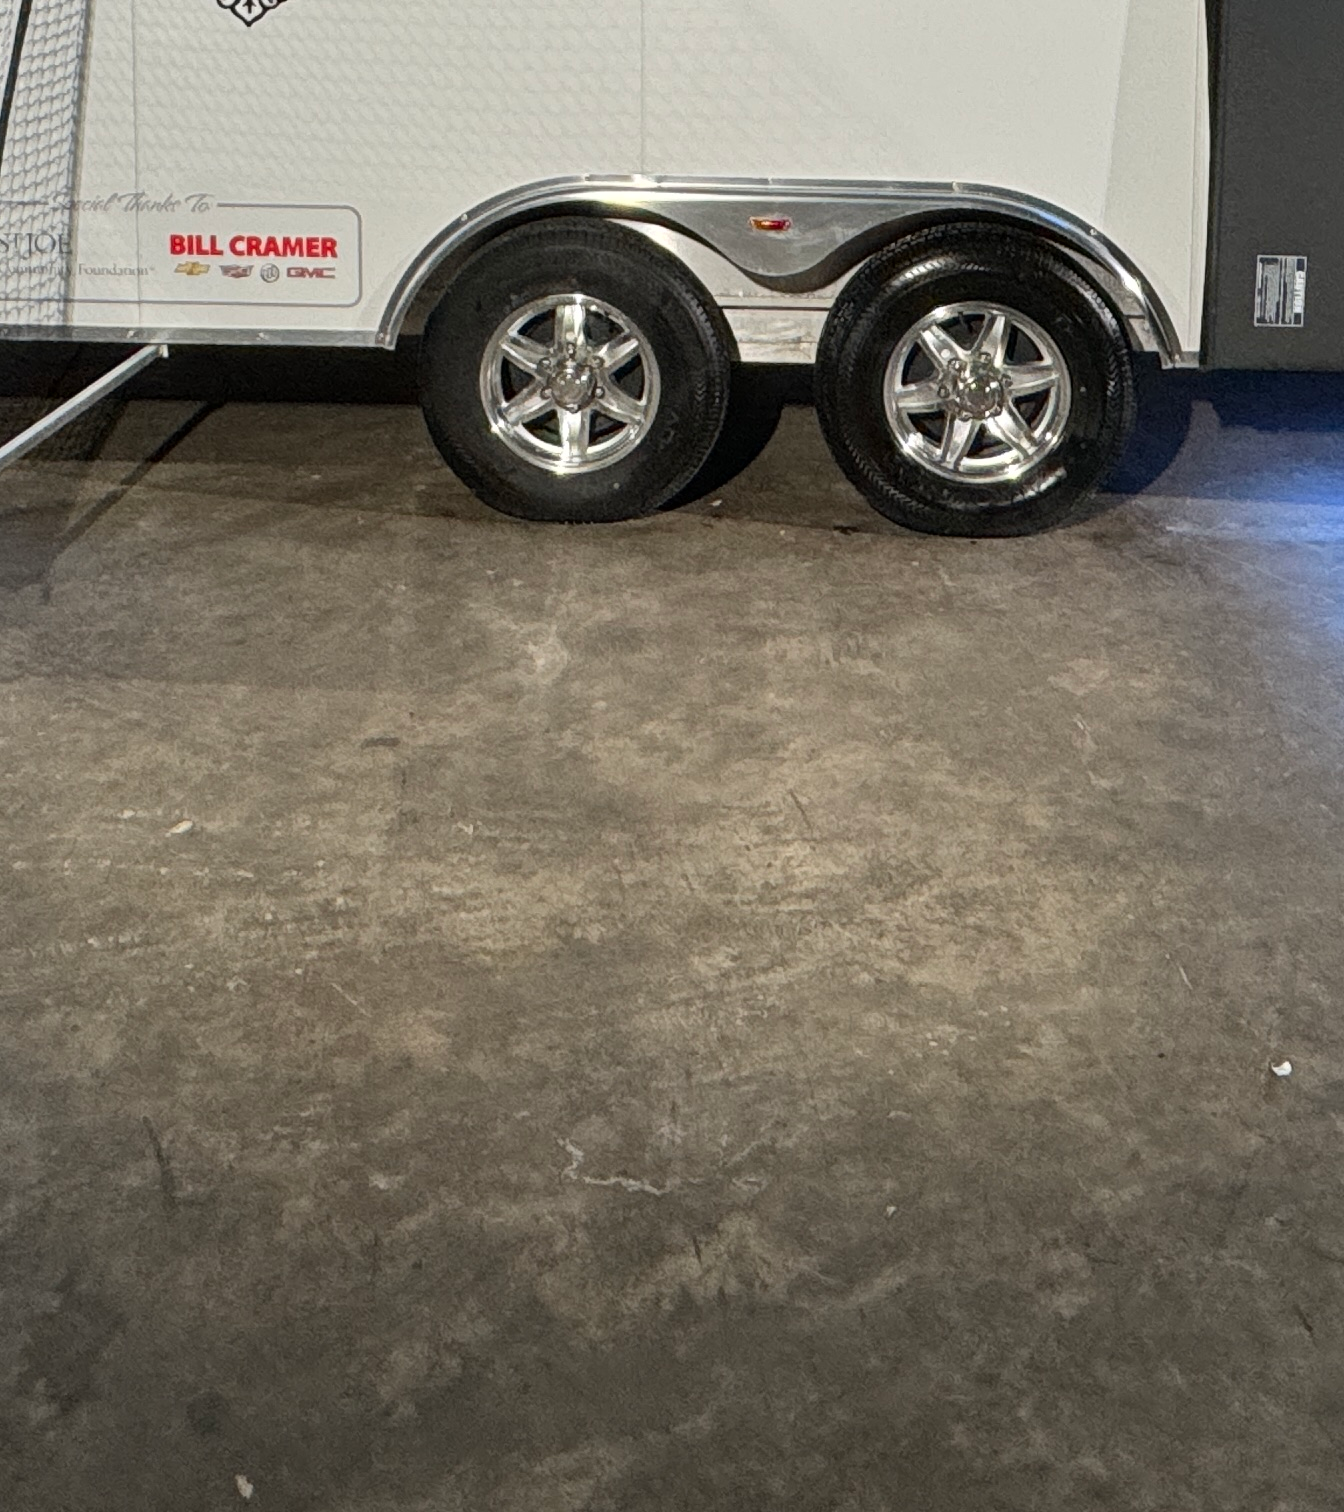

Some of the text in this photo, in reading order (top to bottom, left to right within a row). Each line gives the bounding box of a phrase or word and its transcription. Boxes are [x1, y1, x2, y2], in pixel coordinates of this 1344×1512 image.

[118, 191, 181, 213] Thanks
[185, 193, 214, 213] To
[170, 234, 338, 258] BILL CRAMER
[286, 266, 336, 279] GMC
